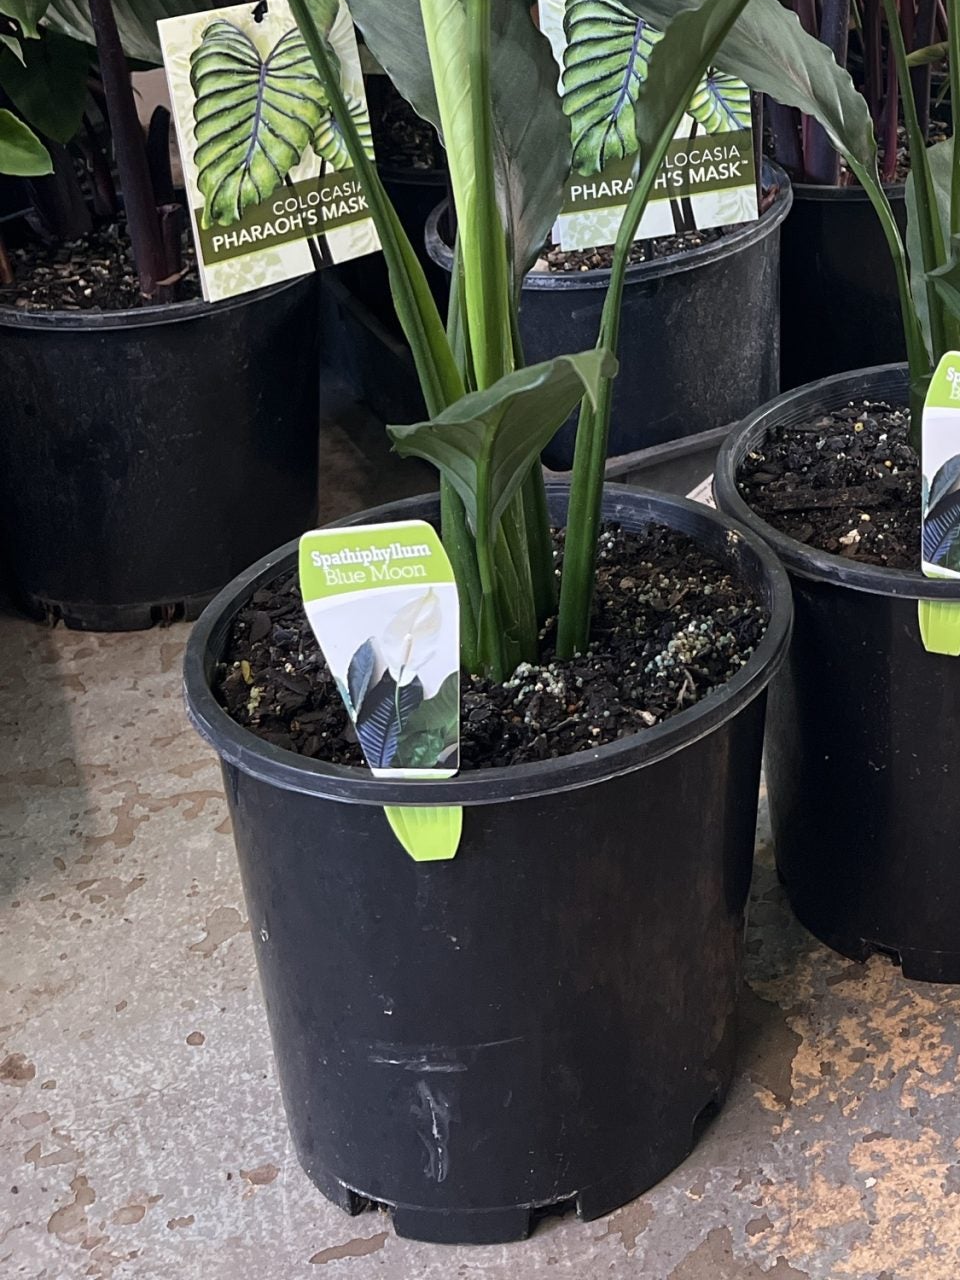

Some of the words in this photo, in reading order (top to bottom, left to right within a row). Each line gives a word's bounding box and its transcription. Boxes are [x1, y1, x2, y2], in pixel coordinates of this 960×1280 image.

[660, 145, 740, 169] LOCASIA
[570, 170, 684, 202] PHARAH'S
[212, 209, 318, 253] PHARAOH'S
[322, 195, 369, 222] MASK
[311, 542, 432, 569] Spathiphyllum
[324, 567, 367, 586] Blue
[370, 564, 427, 582] Moon
